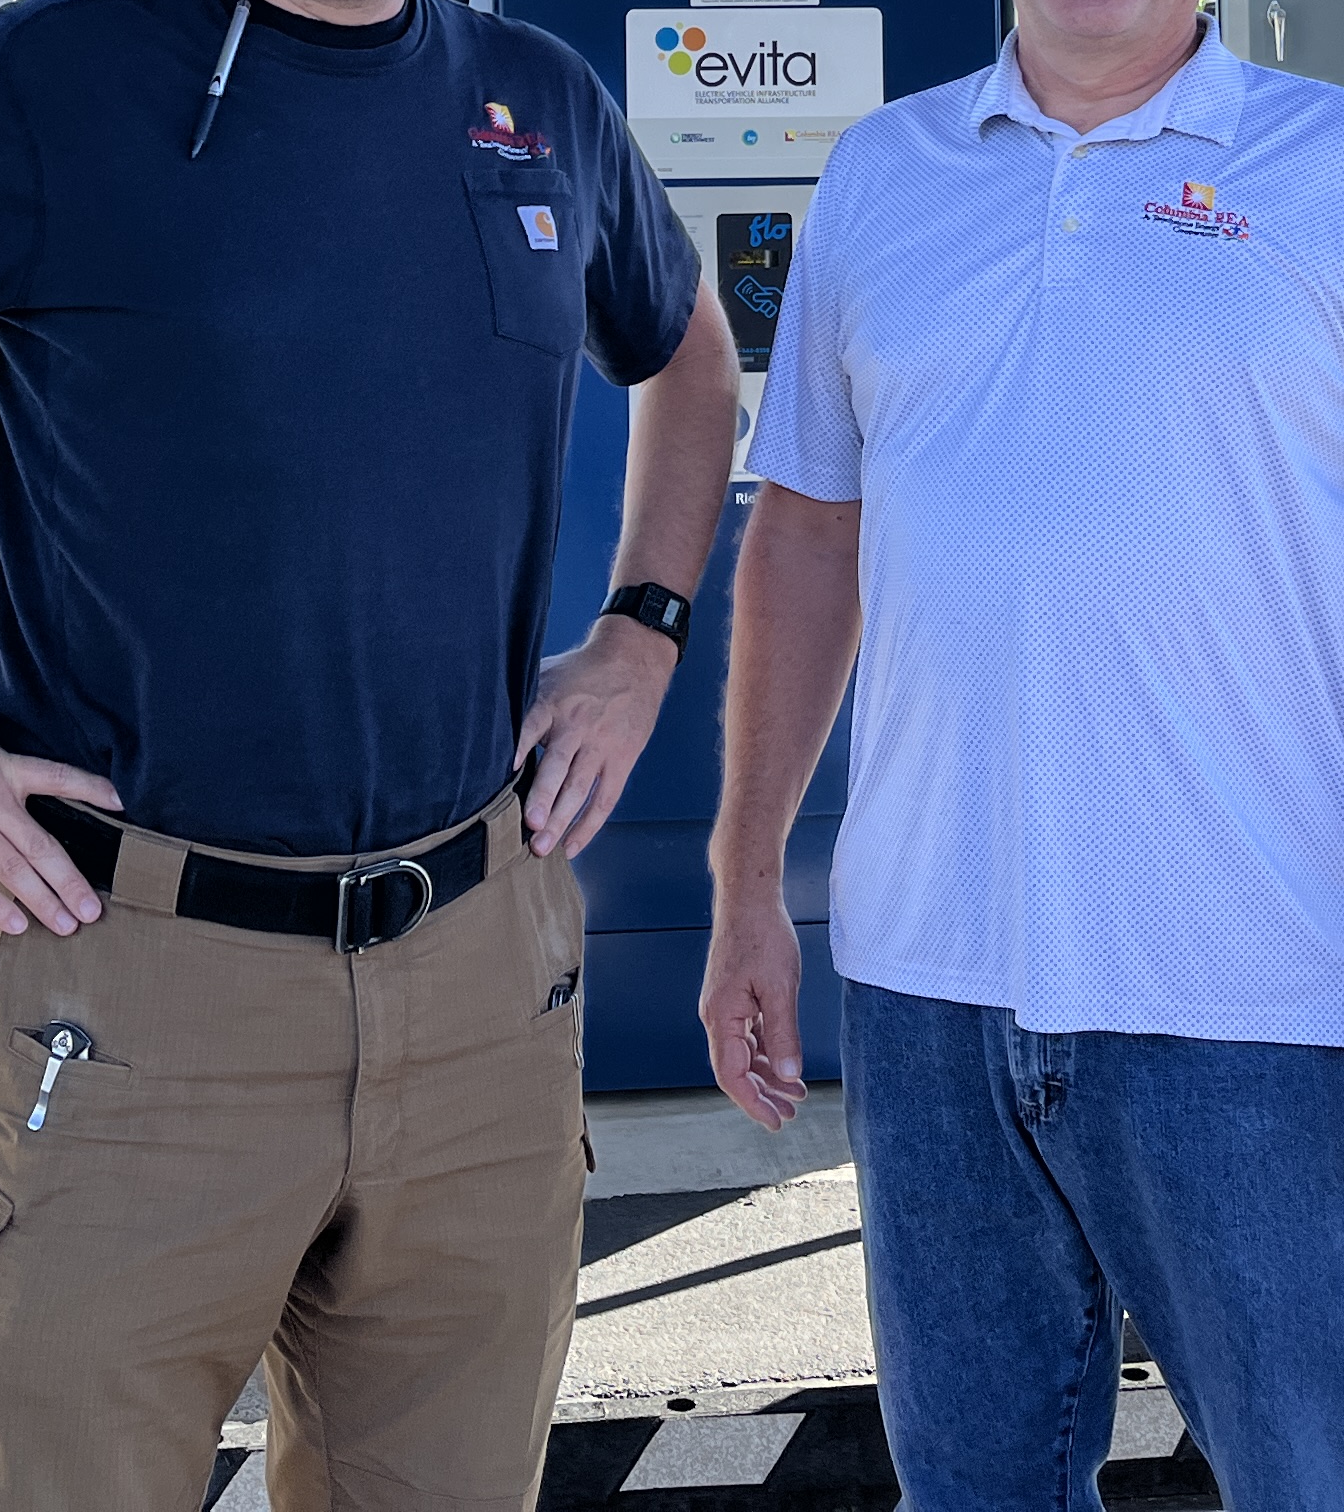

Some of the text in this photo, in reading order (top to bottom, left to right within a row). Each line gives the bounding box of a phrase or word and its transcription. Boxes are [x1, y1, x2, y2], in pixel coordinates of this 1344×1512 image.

[695, 40, 817, 88] evita
[695, 90, 725, 98] ELECTRIC
[756, 89, 817, 97] INFRASTRUCTURE
[695, 97, 756, 105] TRANSPORTATION
[749, 212, 792, 248] flo
